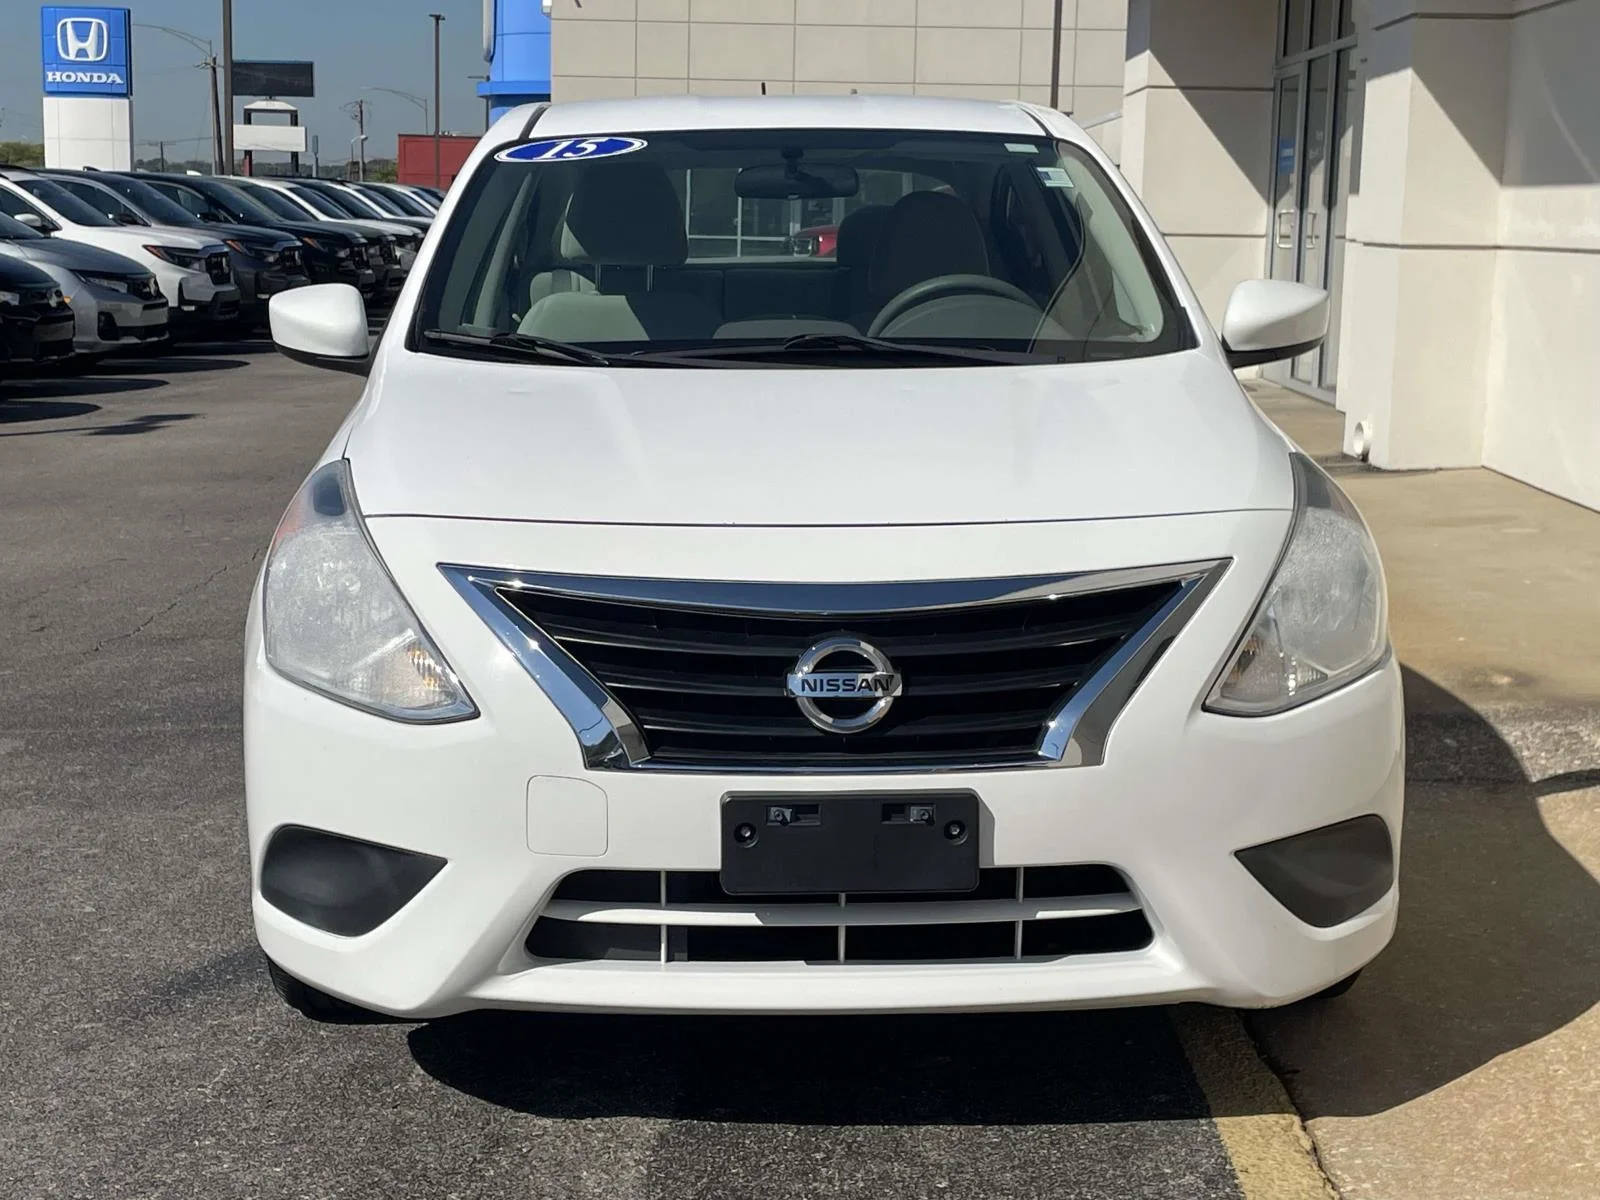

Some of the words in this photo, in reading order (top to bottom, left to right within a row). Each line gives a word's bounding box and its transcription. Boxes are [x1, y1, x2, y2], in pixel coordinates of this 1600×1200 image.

[46, 71, 124, 84] HONDA
[532, 138, 608, 160] 15
[801, 678, 892, 692] NISSAN
